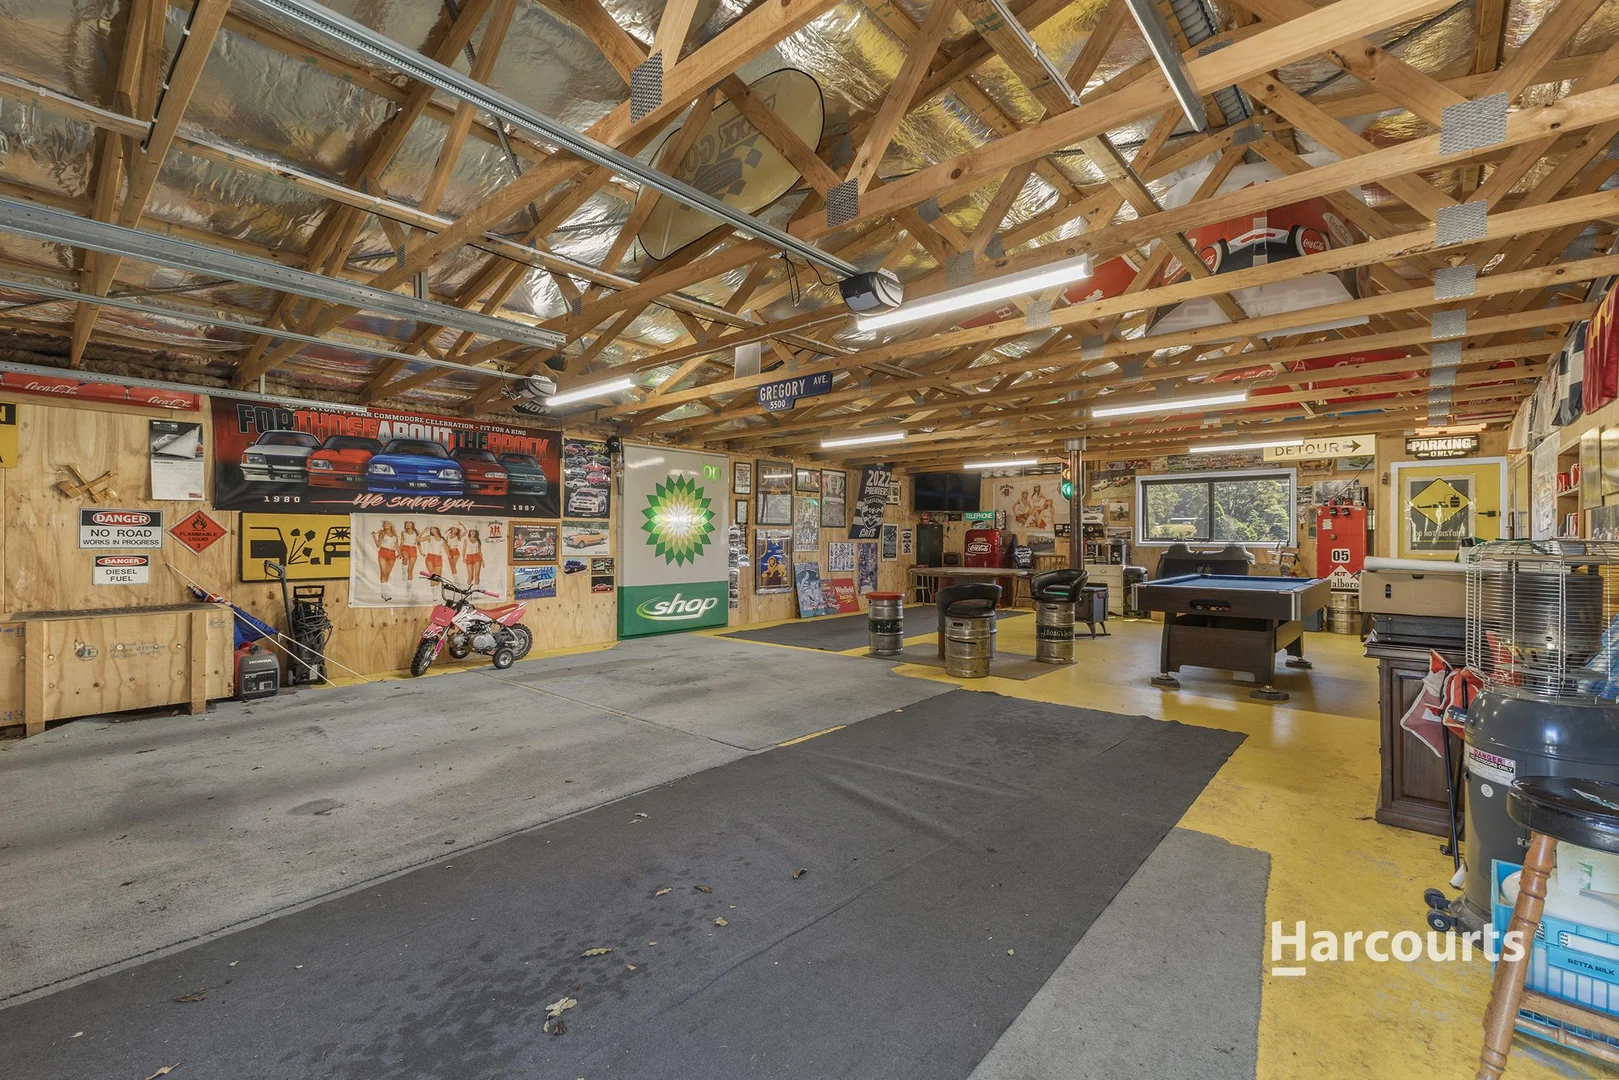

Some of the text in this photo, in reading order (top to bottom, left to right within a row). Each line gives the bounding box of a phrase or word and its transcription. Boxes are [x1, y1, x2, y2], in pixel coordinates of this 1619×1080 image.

[25, 381, 79, 395] Coca-Cola
[760, 374, 829, 401] GREGORY AVE.
[148, 396, 193, 408] Coca-Cola
[770, 400, 786, 409] 5500
[373, 412, 425, 423] COMMODORE
[425, 418, 474, 430] CELEBRATION
[1275, 442, 1339, 456] DETOUR
[1411, 438, 1472, 451] PARKING
[701, 461, 722, 483] bp
[866, 469, 891, 488] 2022
[264, 495, 300, 503] 1980
[353, 492, 476, 513] We salute you
[96, 514, 147, 524] DANGER
[90, 529, 152, 538] NO ROAD
[859, 528, 877, 538] CATS
[969, 544, 989, 552] Coca-Cola
[1333, 550, 1349, 562] 05
[653, 593, 719, 619] shop
[1474, 749, 1504, 765] DANGER
[1498, 764, 1513, 772] ONLY
[1567, 957, 1615, 976] BETTA MILK
